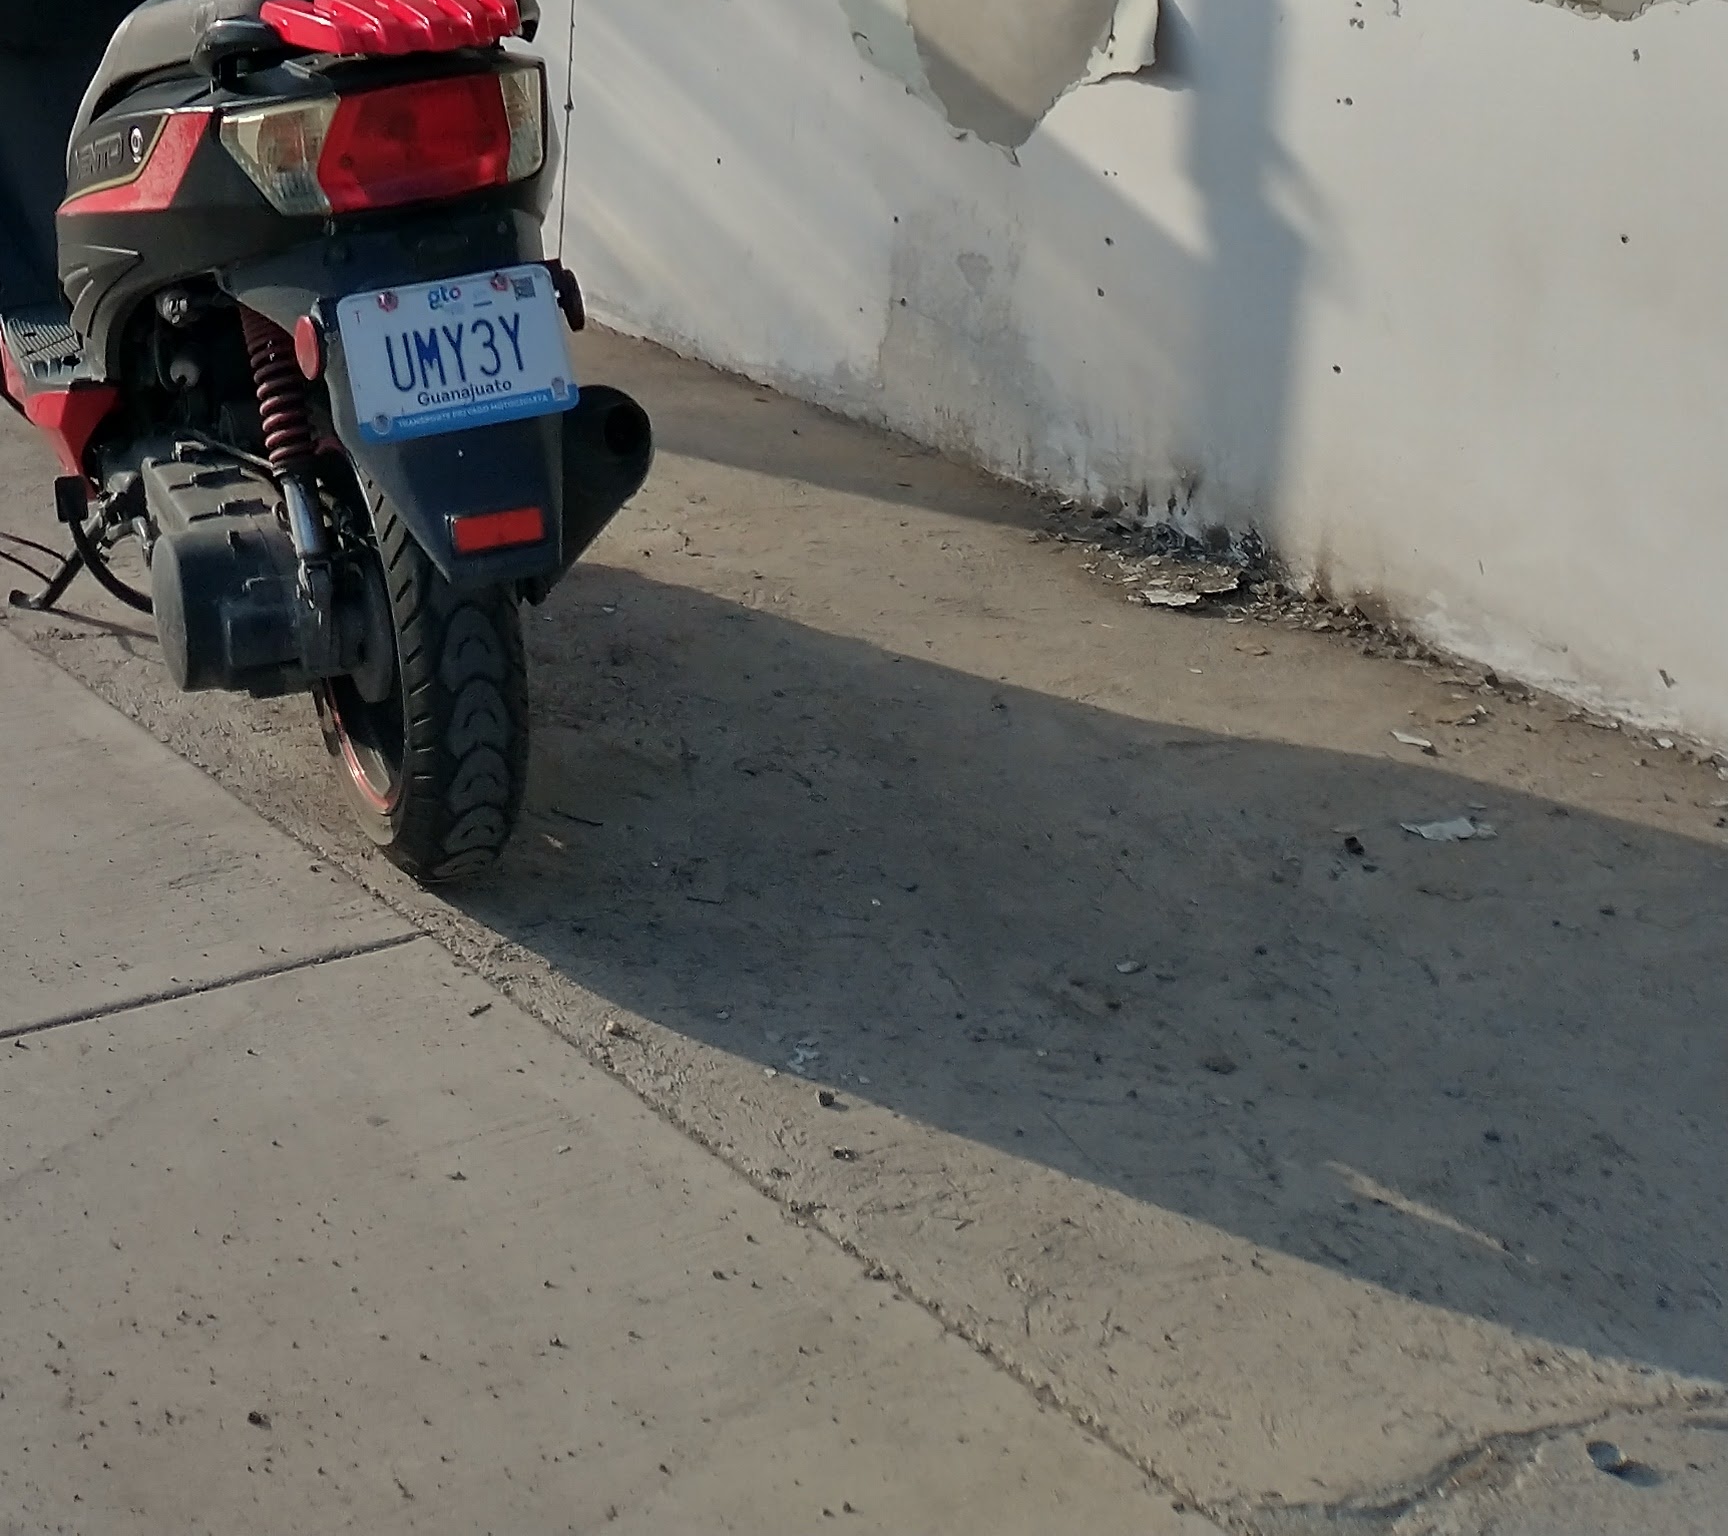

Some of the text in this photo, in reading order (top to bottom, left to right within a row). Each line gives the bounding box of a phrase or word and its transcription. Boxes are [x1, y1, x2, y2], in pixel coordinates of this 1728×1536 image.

[427, 285, 462, 311] gto
[384, 312, 525, 393] UMY3Y
[417, 379, 513, 407] Guanajuato
